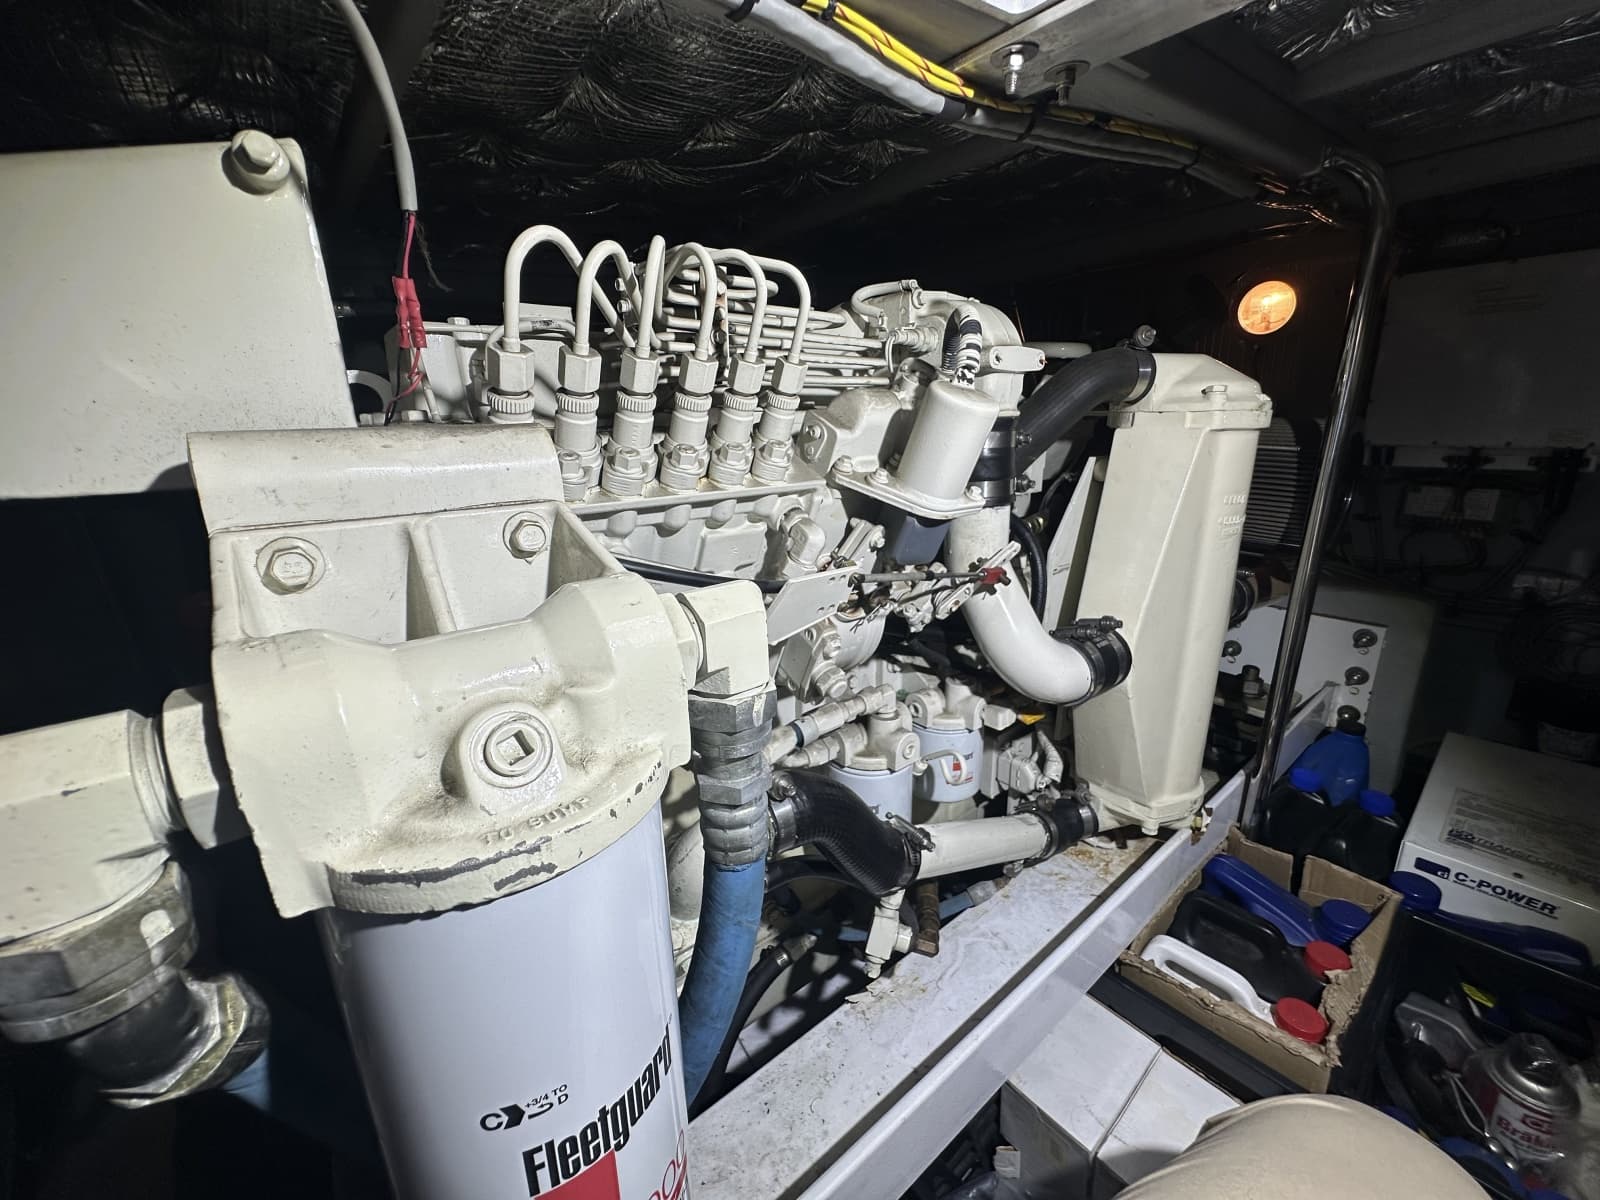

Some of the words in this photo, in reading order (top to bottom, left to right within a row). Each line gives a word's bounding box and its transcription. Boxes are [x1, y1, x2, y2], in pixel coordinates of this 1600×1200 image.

[1454, 871, 1558, 915] C-POWER
[551, 1084, 568, 1096] TO
[557, 1093, 569, 1105] D
[522, 1023, 672, 1198] Fleetguard
[479, 1112, 504, 1132] C
